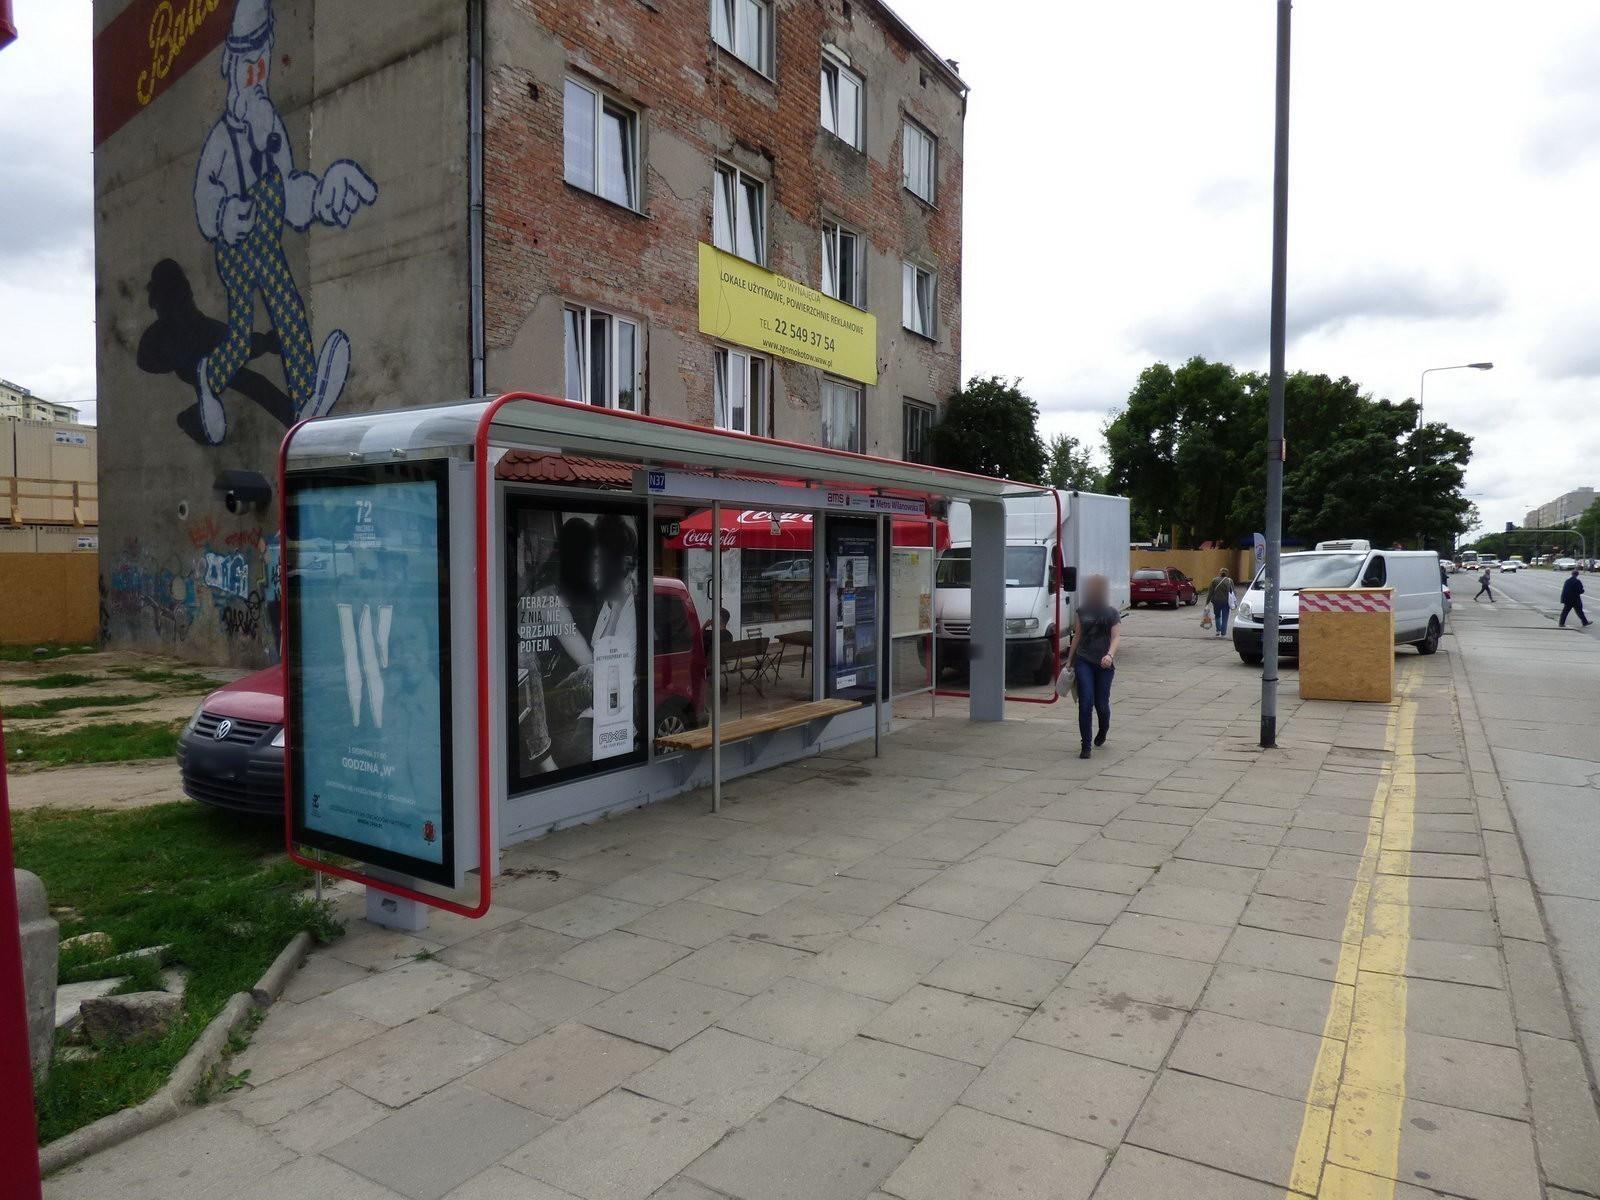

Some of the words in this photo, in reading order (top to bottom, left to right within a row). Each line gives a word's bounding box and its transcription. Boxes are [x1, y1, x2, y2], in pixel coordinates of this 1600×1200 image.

[776, 278, 786, 289] DO
[720, 271, 746, 290] LOKALE
[786, 296, 830, 323] POWIERZCHNIE
[830, 314, 864, 335] REKLAMOWE
[774, 318, 788, 336] 22
[790, 324, 808, 343] 549
[810, 331, 822, 347] 37
[824, 336, 836, 352] 54
[650, 475, 665, 486] N37
[827, 492, 844, 503] ams
[876, 499, 891, 509] Metro
[520, 596, 547, 609] TERAZ
[520, 611, 526, 623] Z
[546, 609, 561, 623] NIE
[520, 624, 562, 639] PRZEJMUJ
[520, 639, 552, 652] POTEM.
[341, 757, 379, 774] GODZINA
